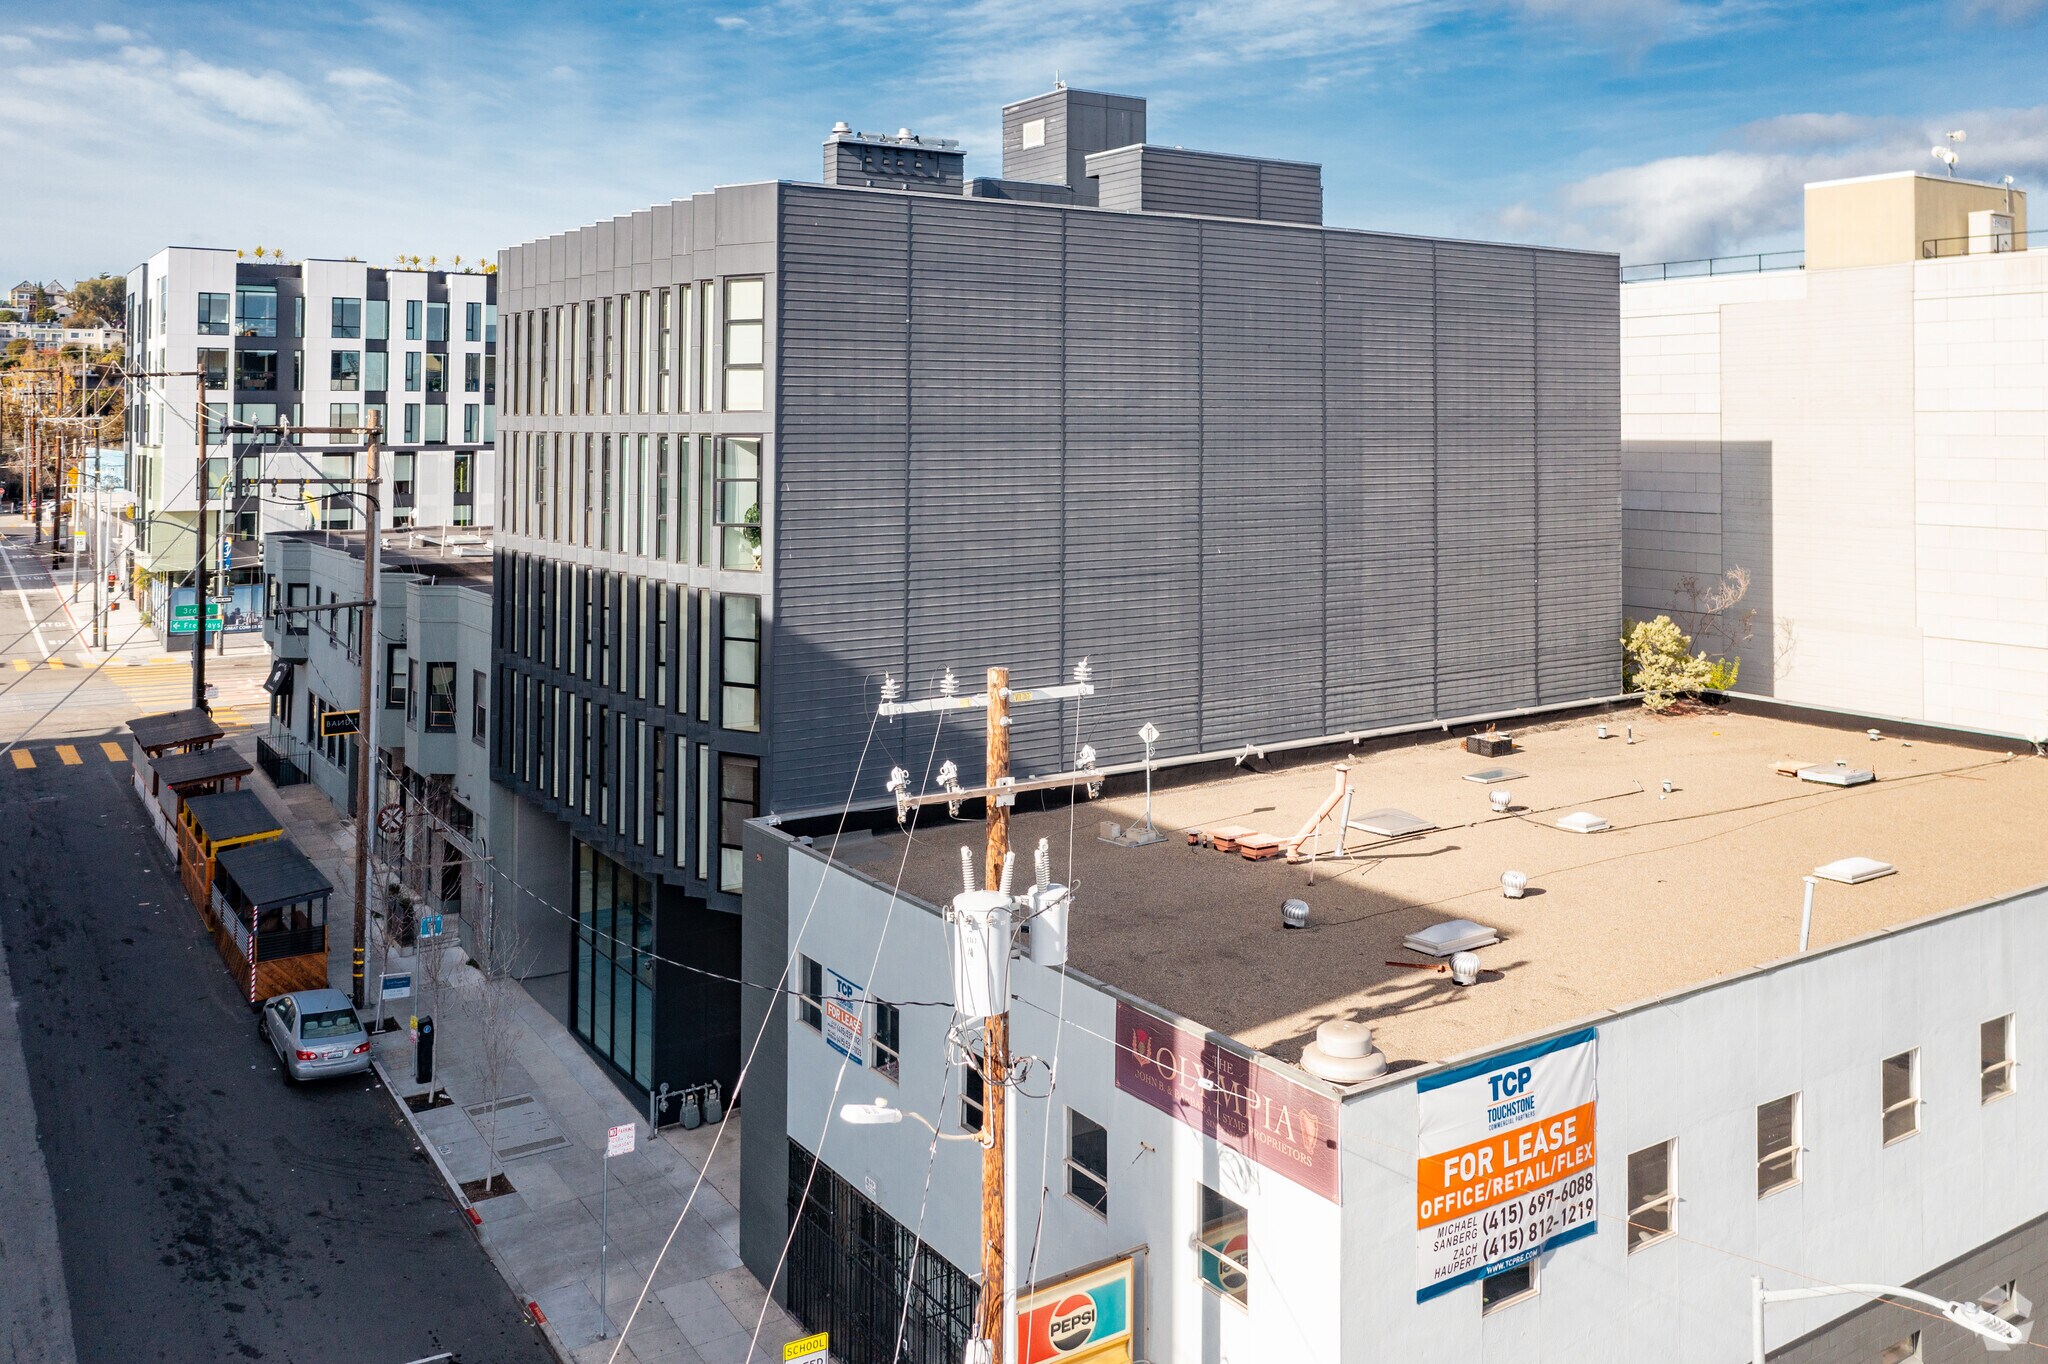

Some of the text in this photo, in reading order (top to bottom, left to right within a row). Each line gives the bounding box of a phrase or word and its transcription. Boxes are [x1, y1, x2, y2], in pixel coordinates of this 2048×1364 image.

[183, 622, 221, 630] Freays
[837, 979, 853, 998] TCP
[828, 1003, 840, 1021] FOR
[841, 1011, 862, 1034] LEASE
[1212, 1056, 1234, 1074] THE
[1157, 1047, 1296, 1144] OLYMPIA
[1488, 1066, 1531, 1101] TCP
[1135, 1070, 1157, 1087] JOHN
[1174, 1089, 1212, 1115] BARBARA
[1249, 1127, 1313, 1167] PROPRIETORS
[1487, 1095, 1535, 1123] TOUCHSTONE
[1489, 1110, 1536, 1131] COMMERCIAL PARTNERS
[1444, 1115, 1577, 1188] FOR LEASE
[1420, 1141, 1593, 1219] OFFICE/RETAIL/FLEX
[1483, 1172, 1593, 1235] (415) 697-6088
[1433, 1228, 1478, 1252] SANBERG
[1437, 1216, 1478, 1239] MICHAEL
[1483, 1198, 1594, 1262] (415) 812-1219
[1453, 1243, 1478, 1260] ZACH
[1486, 1249, 1538, 1275] WWW.TCPRE.COM
[1434, 1255, 1478, 1279] HAUPERT
[1051, 1309, 1095, 1337] PEPSI
[787, 1338, 825, 1357] SCHOOL
